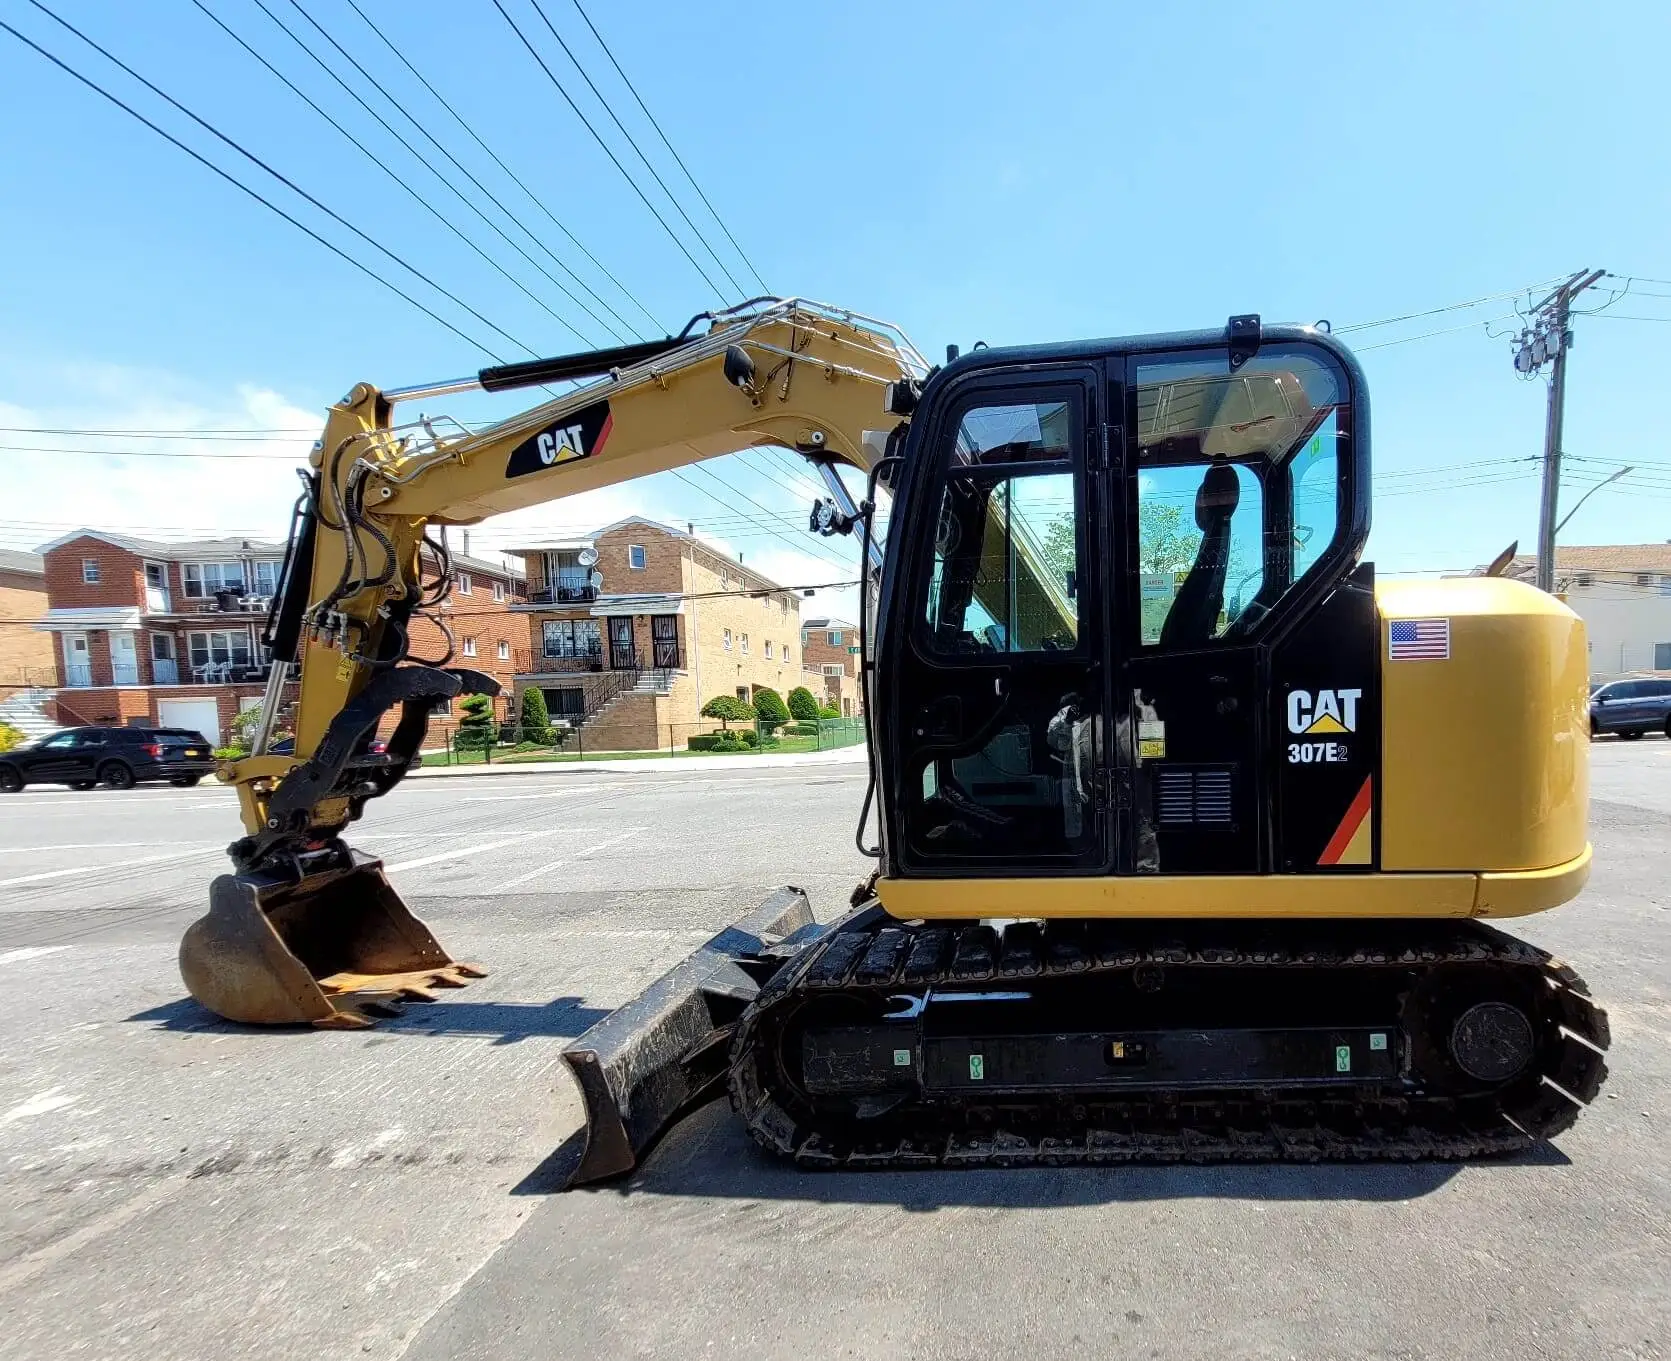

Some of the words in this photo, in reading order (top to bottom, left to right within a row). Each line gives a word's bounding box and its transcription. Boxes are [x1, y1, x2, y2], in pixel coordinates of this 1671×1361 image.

[538, 425, 584, 464] CAT
[1287, 688, 1361, 734] CAT
[1287, 742, 1348, 763] 307E2
